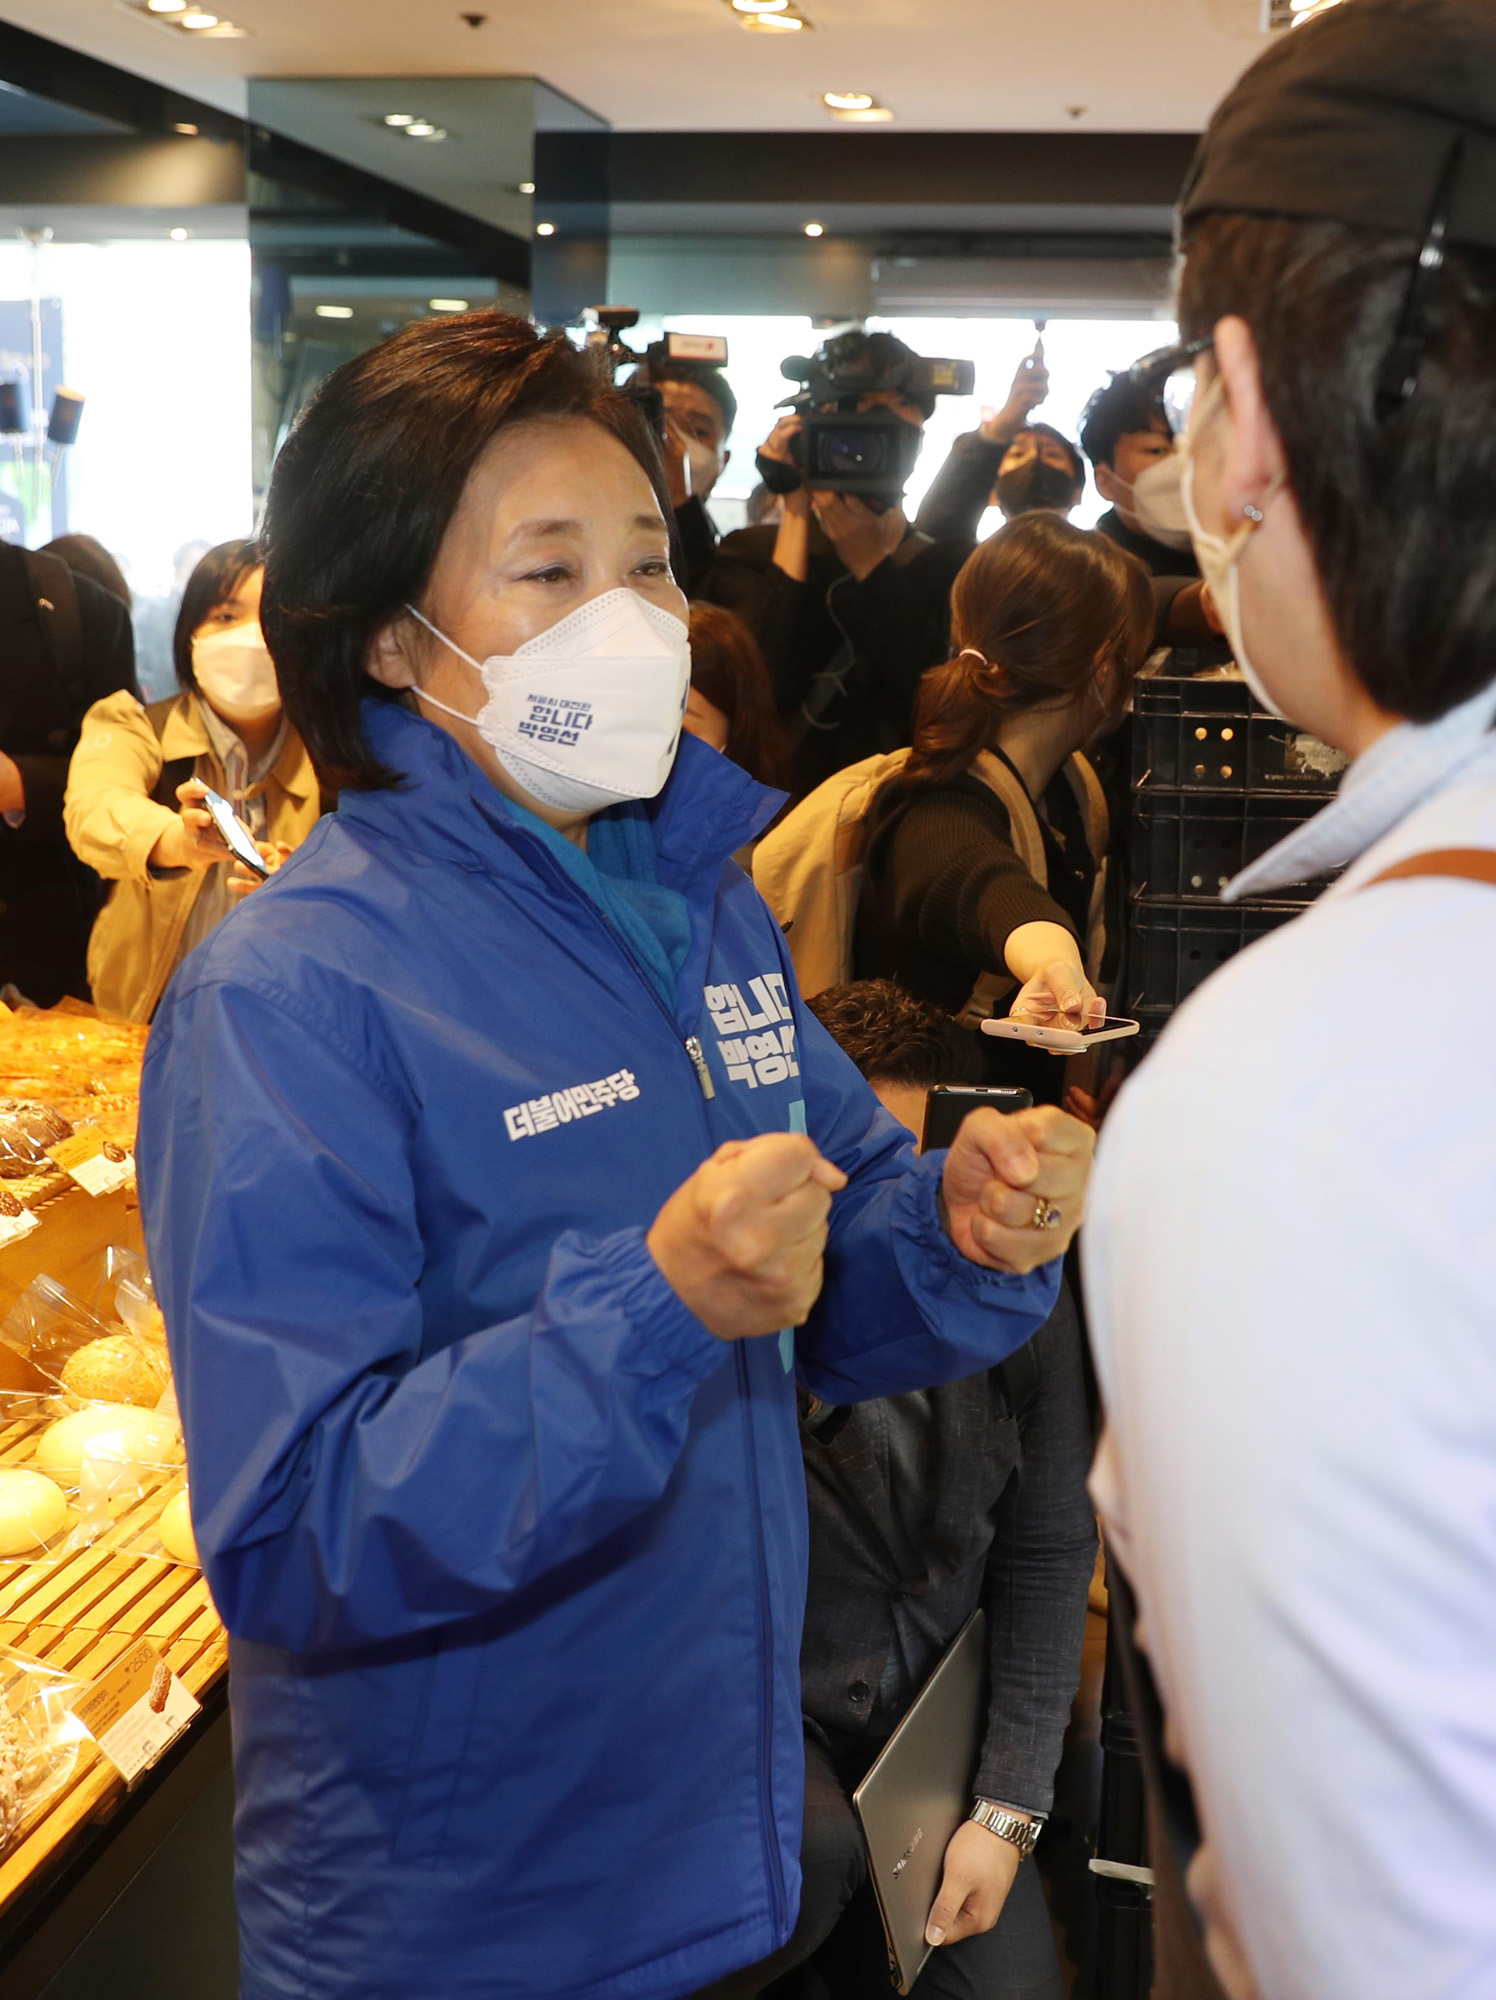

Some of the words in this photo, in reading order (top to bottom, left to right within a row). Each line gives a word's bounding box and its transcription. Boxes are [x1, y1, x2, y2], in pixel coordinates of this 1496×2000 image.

[529, 705, 593, 730] 합니다
[518, 721, 580, 746] 박영선
[502, 1069, 641, 1142] 더불어민주당
